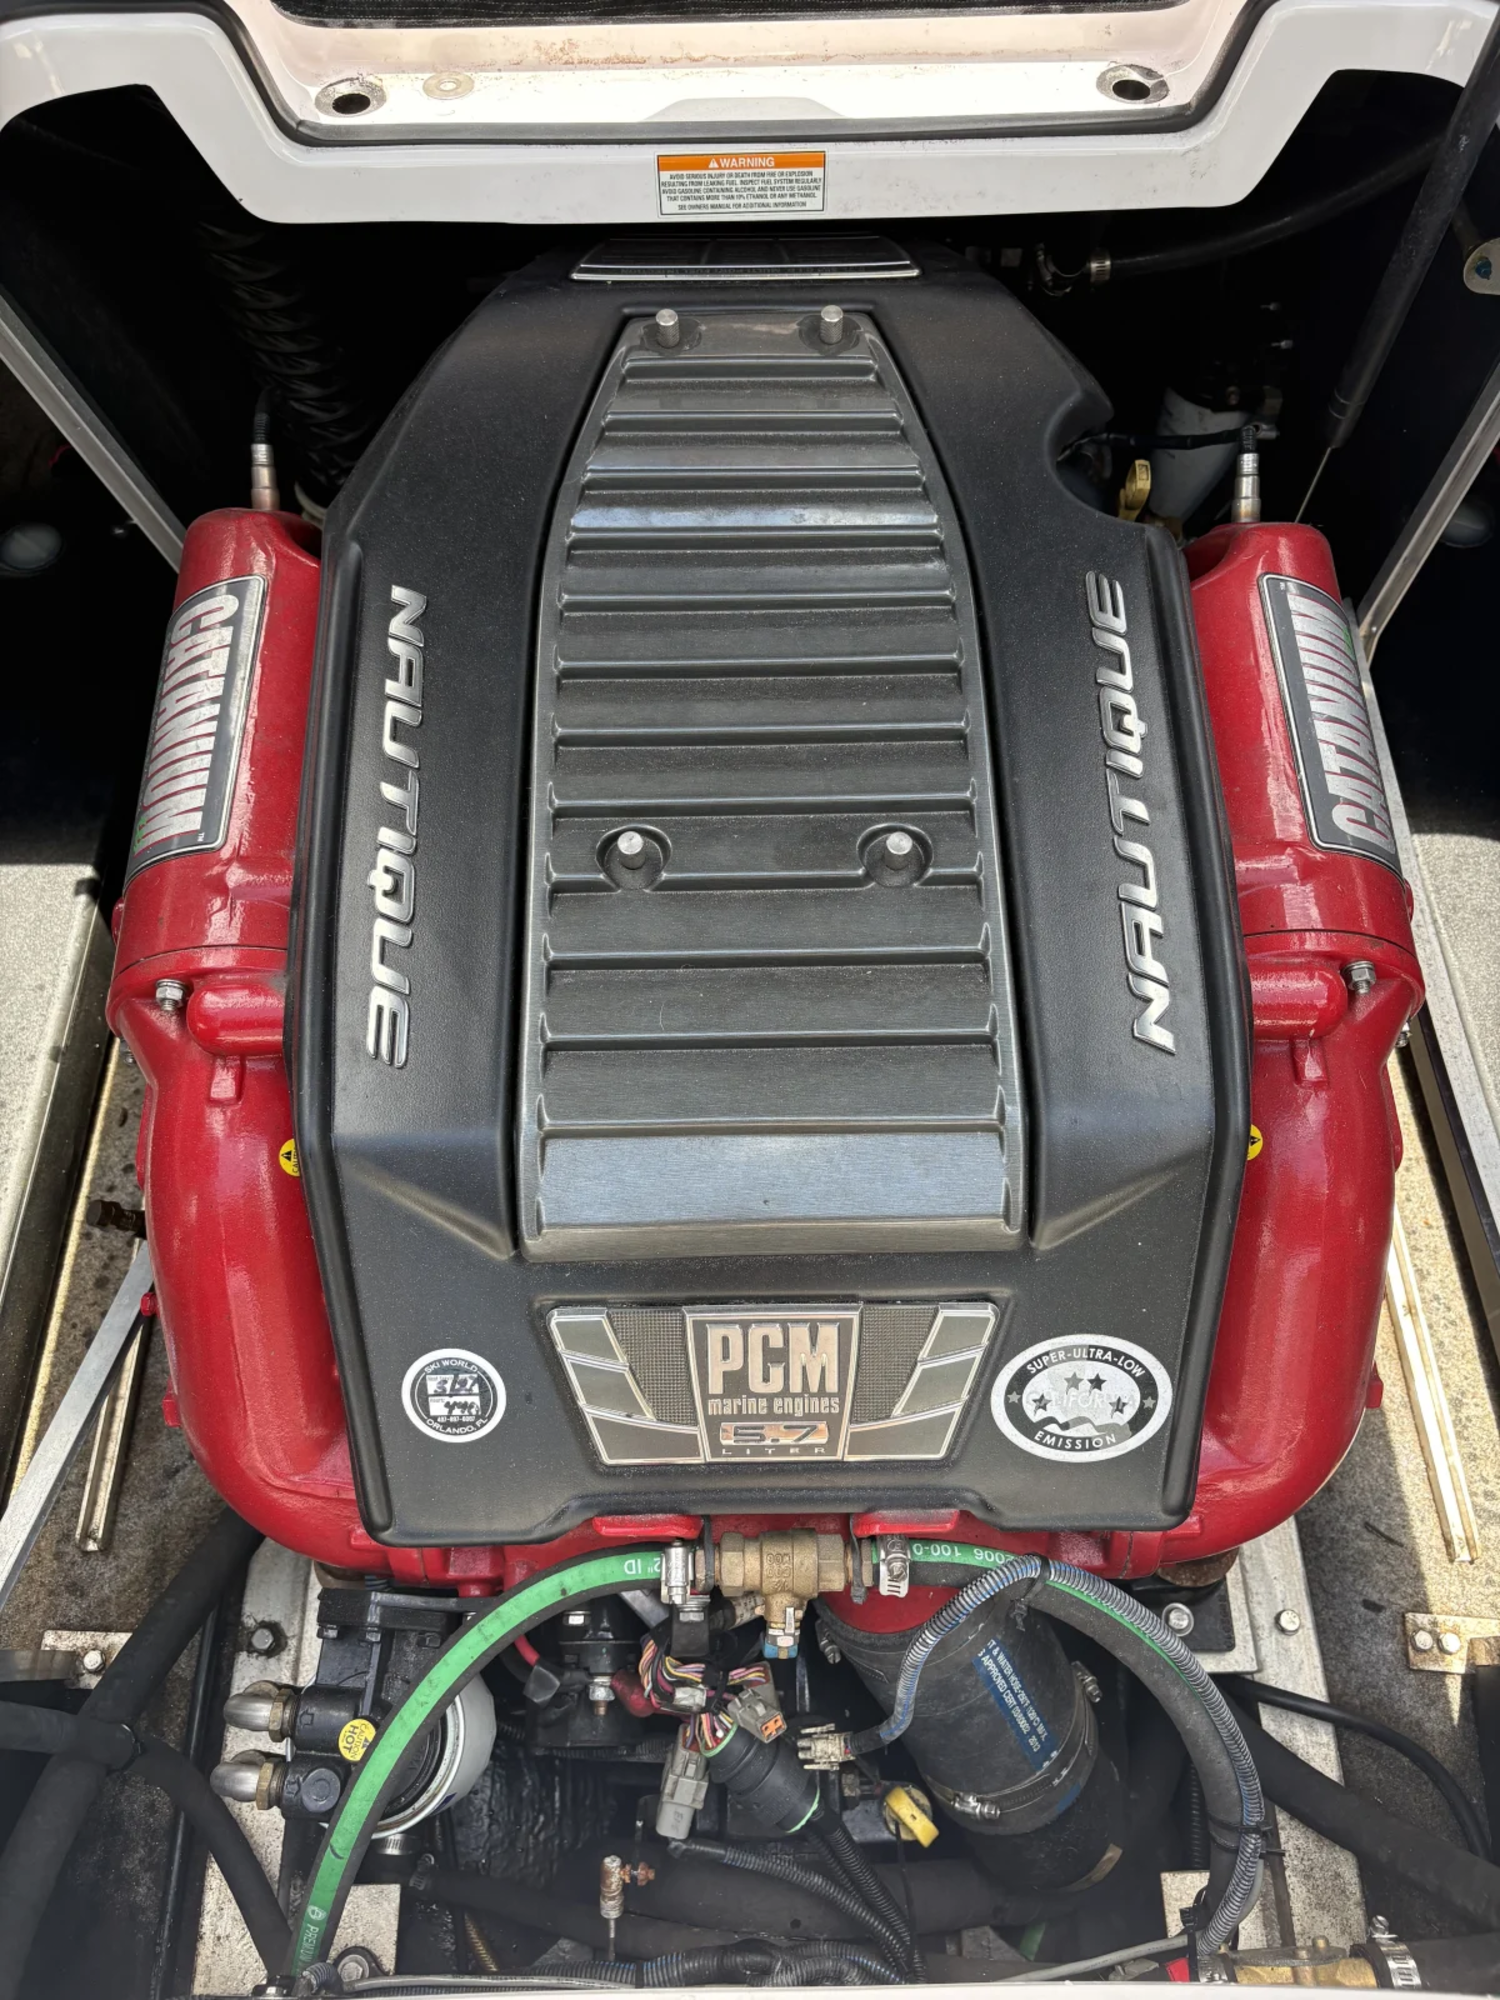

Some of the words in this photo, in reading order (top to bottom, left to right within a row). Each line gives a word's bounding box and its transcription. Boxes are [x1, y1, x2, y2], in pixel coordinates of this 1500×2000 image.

[719, 157, 775, 168] WARNING
[134, 594, 239, 858] CATANIUM
[1287, 593, 1396, 854] CATANIUM
[1084, 570, 1176, 1055] NAUTIQUE
[366, 584, 427, 1069] NAUTIQUE
[425, 1362, 440, 1374] SKI
[442, 1359, 478, 1372] WORLD
[706, 1322, 840, 1394] PCM
[1027, 1347, 1146, 1378] SUPER-ULTRA-LOW
[708, 1395, 768, 1415] marine
[773, 1394, 840, 1416] engines
[476, 1417, 488, 1428] FL
[733, 1425, 818, 1443] 5.7
[722, 1447, 825, 1455] LITER
[1034, 1430, 1116, 1449] EMISSION
[623, 1558, 642, 1575] ID
[996, 1652, 1014, 1675] WATER
[981, 1654, 1007, 1692] APPROVED
[1003, 1689, 1017, 1708] CERT
[343, 1724, 359, 1754] HOT
[350, 1723, 367, 1760] CAUTION
